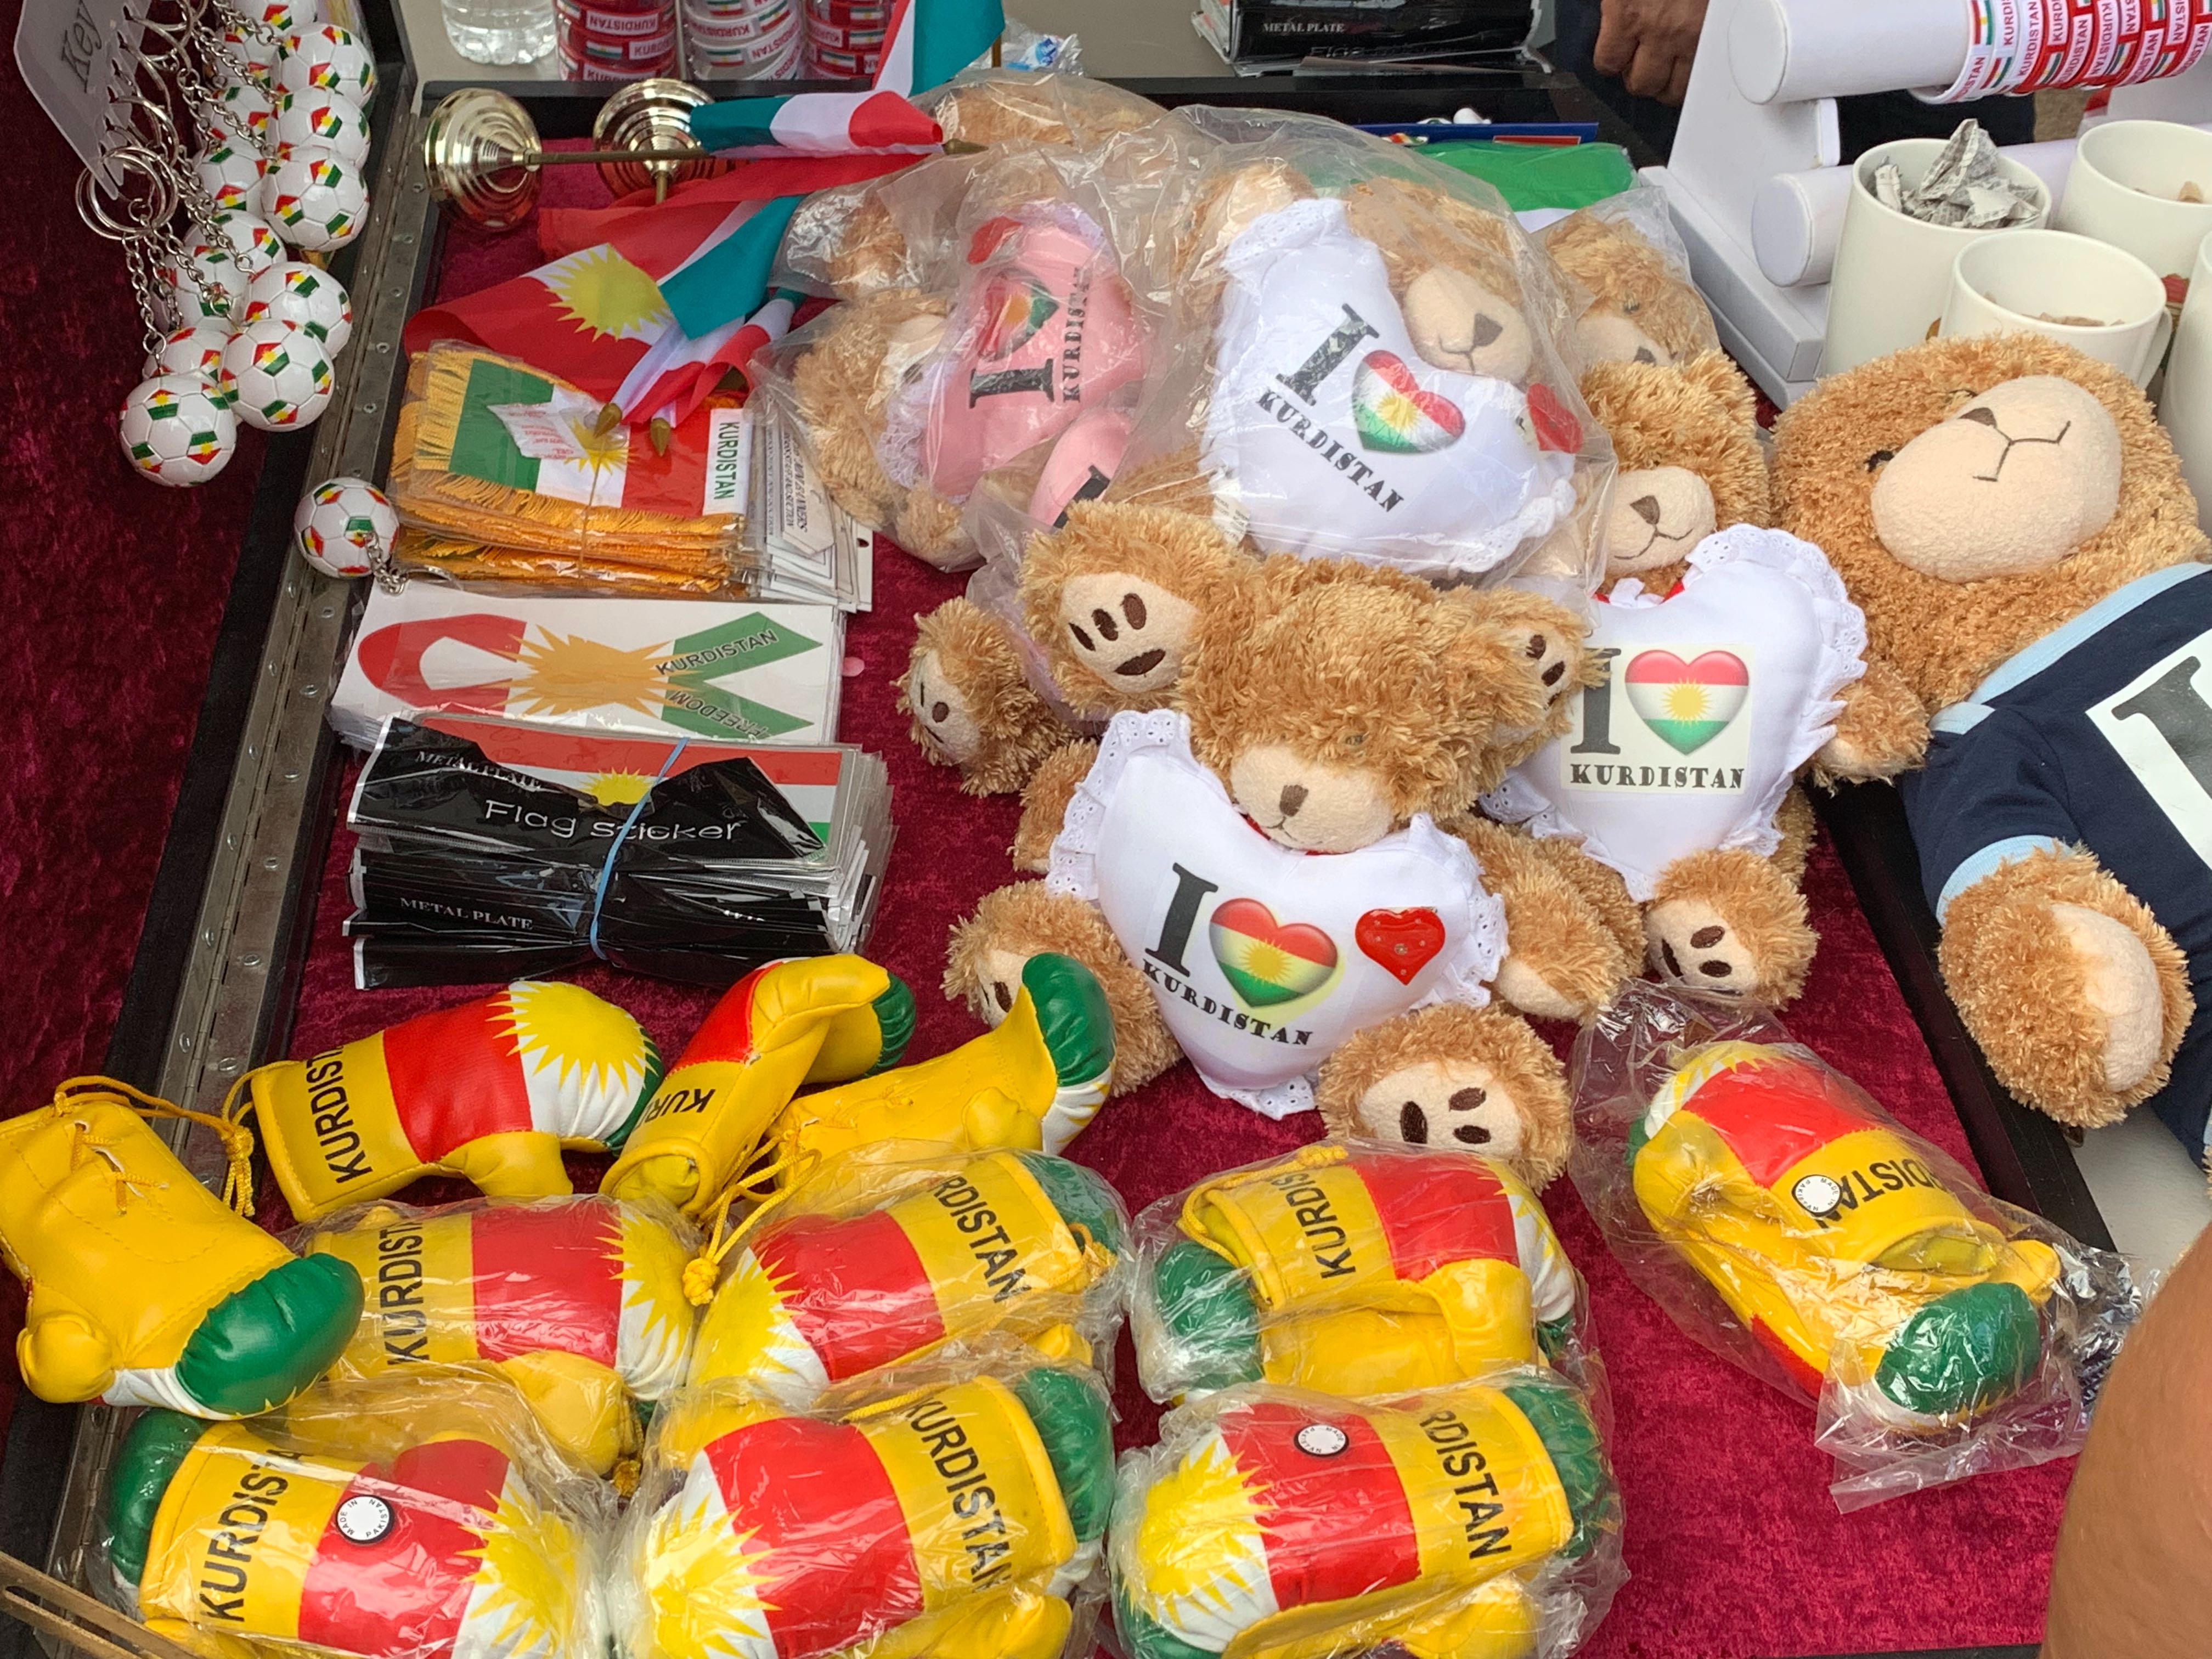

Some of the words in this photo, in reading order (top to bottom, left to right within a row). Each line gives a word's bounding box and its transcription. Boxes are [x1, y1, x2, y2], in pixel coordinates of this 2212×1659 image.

[62, 0, 101, 93] Key
[589, 15, 656, 33] KURDISTAN
[1263, 23, 1304, 32] METAL
[1308, 24, 1345, 33] PLATE
[2018, 2, 2039, 76] KURDISTAN
[2090, 2, 2113, 75] KURDISTAN
[969, 359, 1054, 409] I
[1276, 303, 1380, 407] I
[713, 421, 740, 500] KURDISTAN
[1257, 390, 1404, 514] KURDISTAN
[656, 629, 778, 675] KURDISTAN
[669, 690, 770, 738] FREEDOM
[1570, 647, 1622, 755] I
[1570, 763, 1745, 789] KURDISTAN
[485, 799, 577, 838] Flag
[400, 897, 469, 918] METAL
[472, 910, 533, 930] PLATE
[1145, 862, 1218, 978] I
[1142, 958, 1313, 1046] KURDISTAN
[306, 1045, 374, 1184] KURDIST
[378, 1221, 430, 1365] KURDIST
[340, 1511, 356, 1536] MADE
[347, 1499, 358, 1508] IN
[365, 1498, 388, 1538] PAKISTAN
